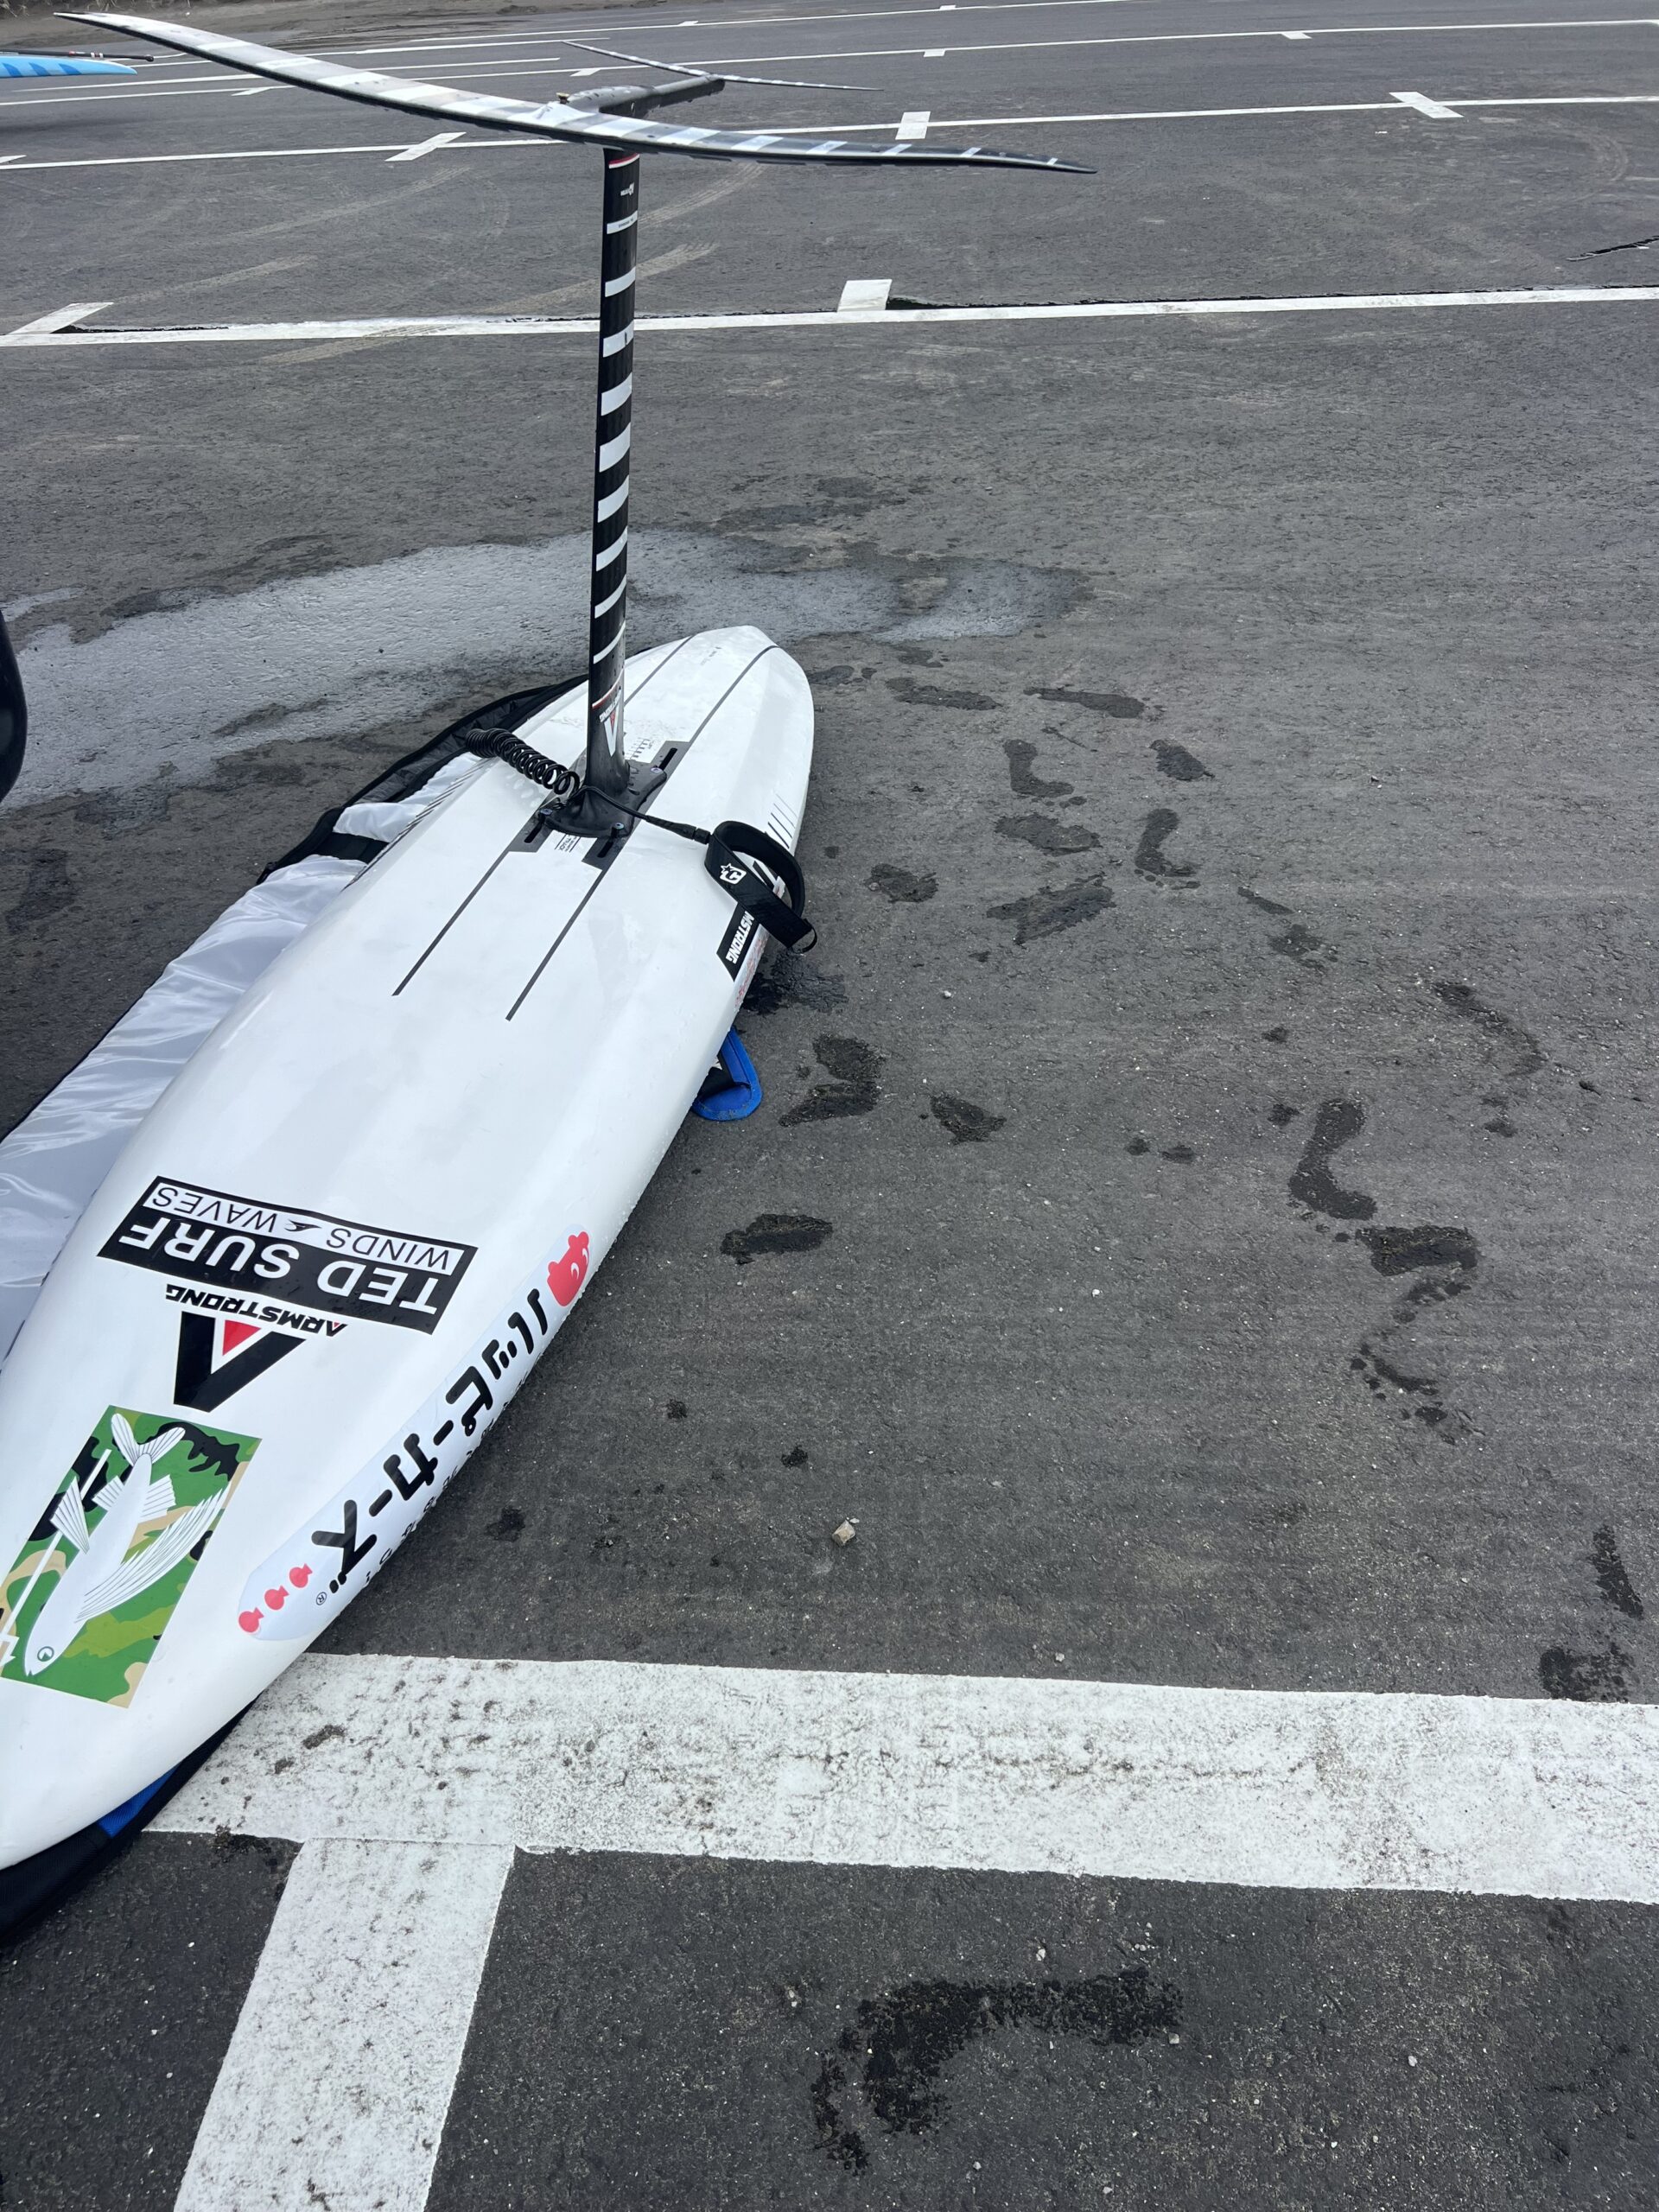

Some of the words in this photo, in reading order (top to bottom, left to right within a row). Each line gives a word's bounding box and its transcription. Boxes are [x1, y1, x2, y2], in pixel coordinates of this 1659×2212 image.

[725, 910, 755, 965] MSTRONG
[152, 1187, 277, 1233] WAVES
[118, 1217, 300, 1279] SURF
[326, 1228, 449, 1270] WINDS
[165, 1283, 348, 1338] ARMSTRONG
[317, 1261, 439, 1315] TED
